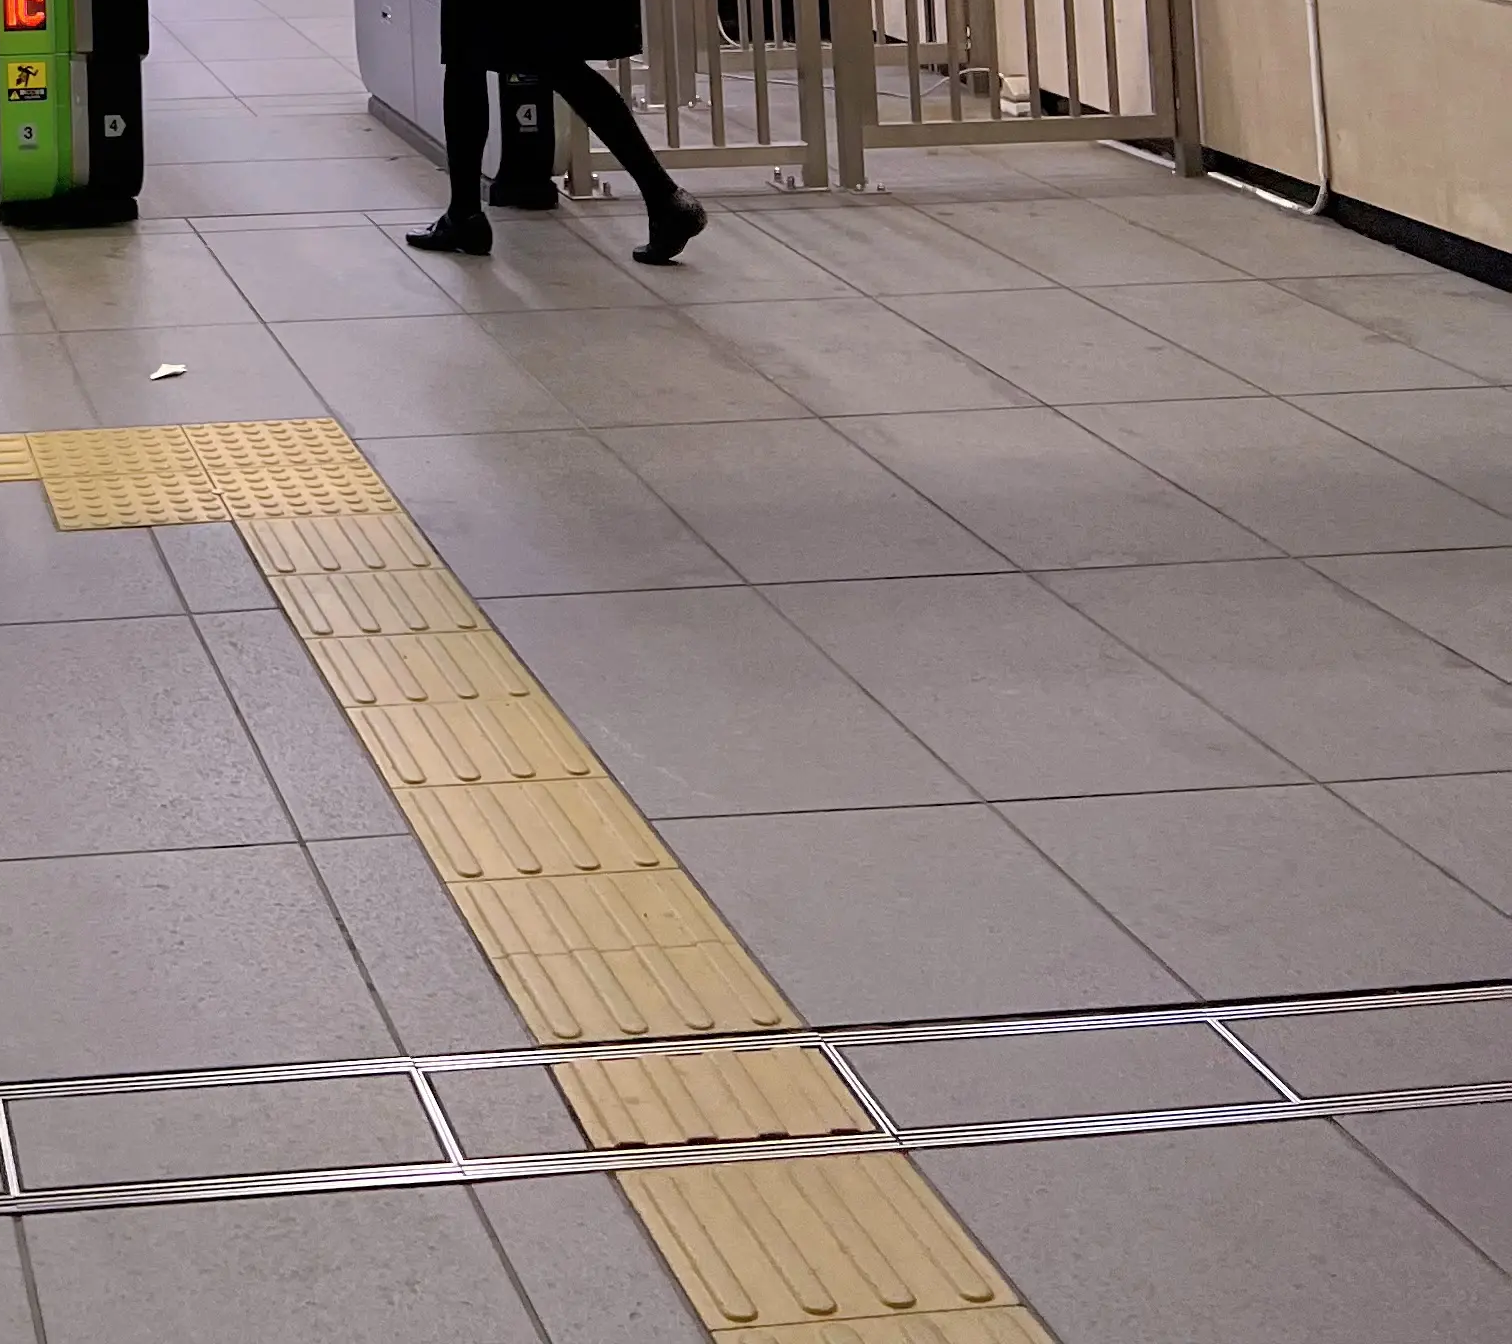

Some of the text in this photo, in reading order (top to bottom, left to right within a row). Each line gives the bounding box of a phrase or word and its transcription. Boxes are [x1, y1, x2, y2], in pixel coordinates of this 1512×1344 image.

[522, 108, 533, 121] 4
[109, 118, 119, 132] 4
[23, 126, 33, 139] 3
